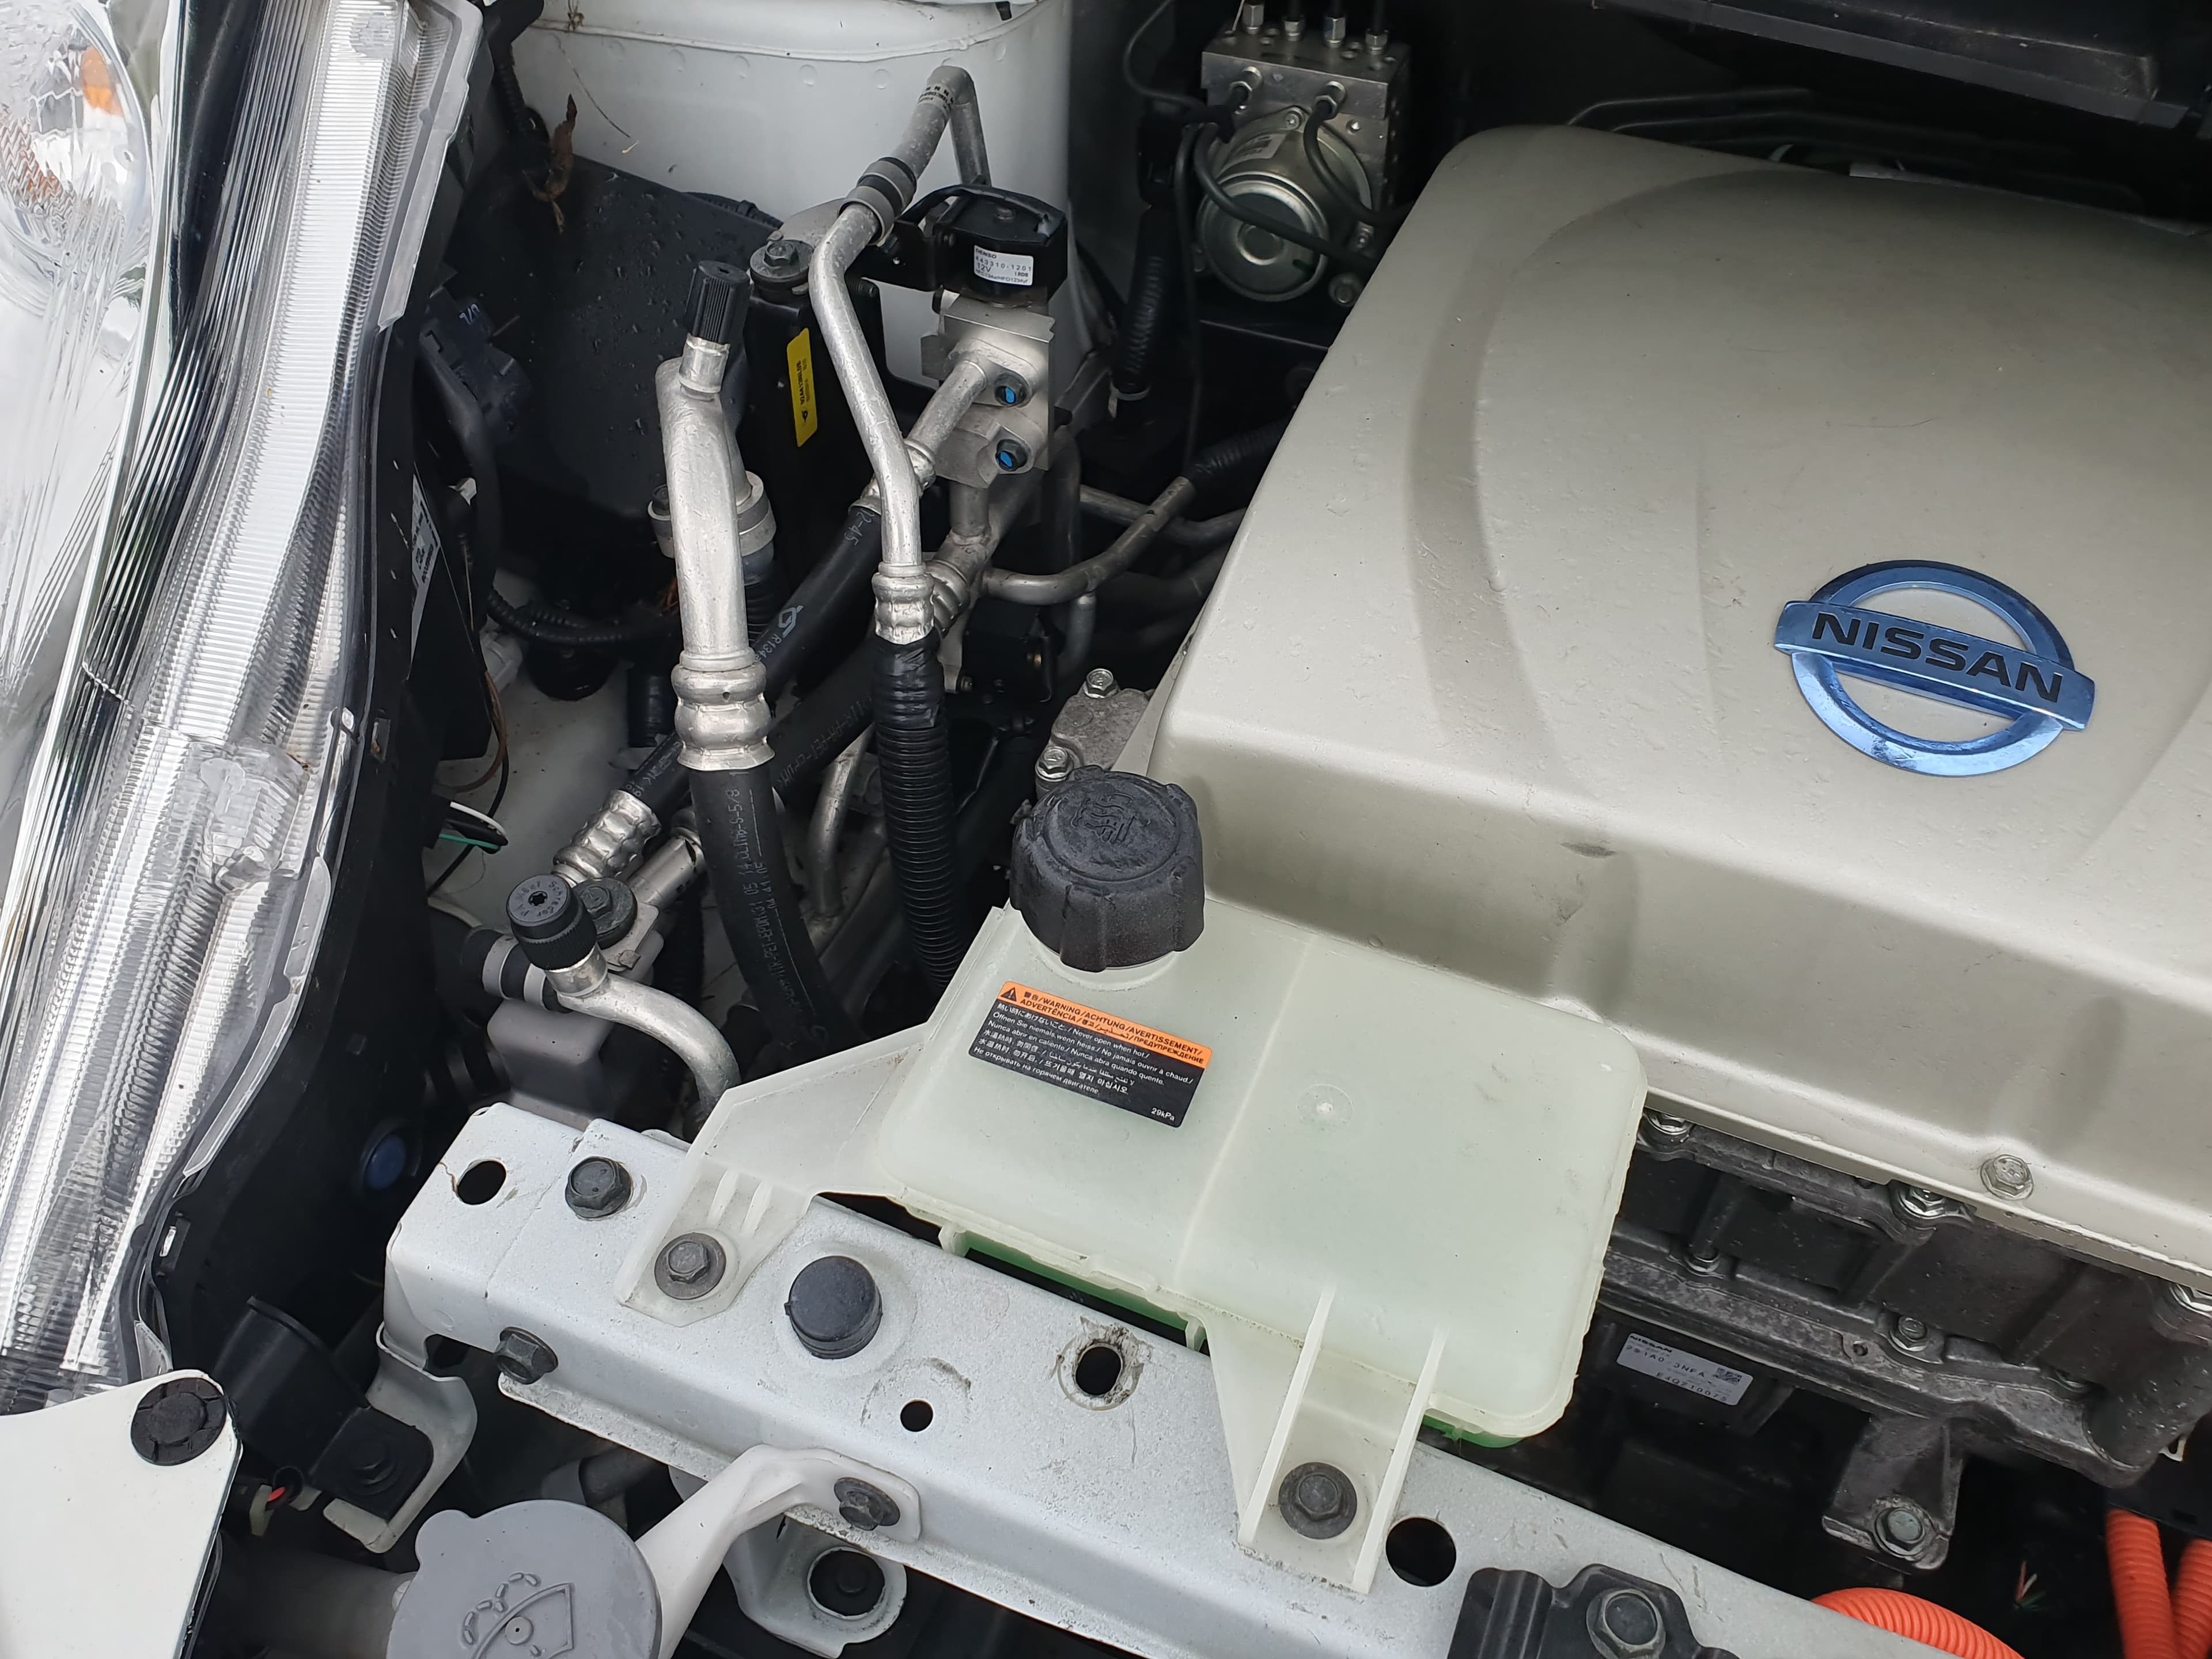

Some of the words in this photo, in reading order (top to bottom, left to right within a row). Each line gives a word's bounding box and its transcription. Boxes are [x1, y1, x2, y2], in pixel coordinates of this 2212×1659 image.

[976, 249, 997, 259] DENSO
[977, 262, 991, 272] 12V
[1812, 612, 2063, 703] NISSAN
[987, 1020, 1012, 1033] Nunca
[1010, 1028, 1028, 1039] abrir
[1070, 1048, 1094, 1061] Nunca
[1093, 1056, 1111, 1067] abra
[1109, 1062, 1138, 1077] quando
[1015, 1018, 1029, 1028] Sie
[1100, 1048, 1113, 1057] Ne
[1112, 1052, 1137, 1066] jamais
[1136, 1060, 1158, 1073] ouvrir
[1071, 1028, 1093, 1040] Never
[1093, 1036, 1112, 1047] open
[1111, 1041, 1133, 1054] when
[973, 1046, 985, 1055] Не
[983, 1050, 1021, 1069] открывать
[1021, 1063, 1032, 1071] на
[1031, 1066, 1062, 1084] горячем
[1150, 1107, 1176, 1122] 29kPa
[1630, 1335, 1672, 1353] NISSAN
